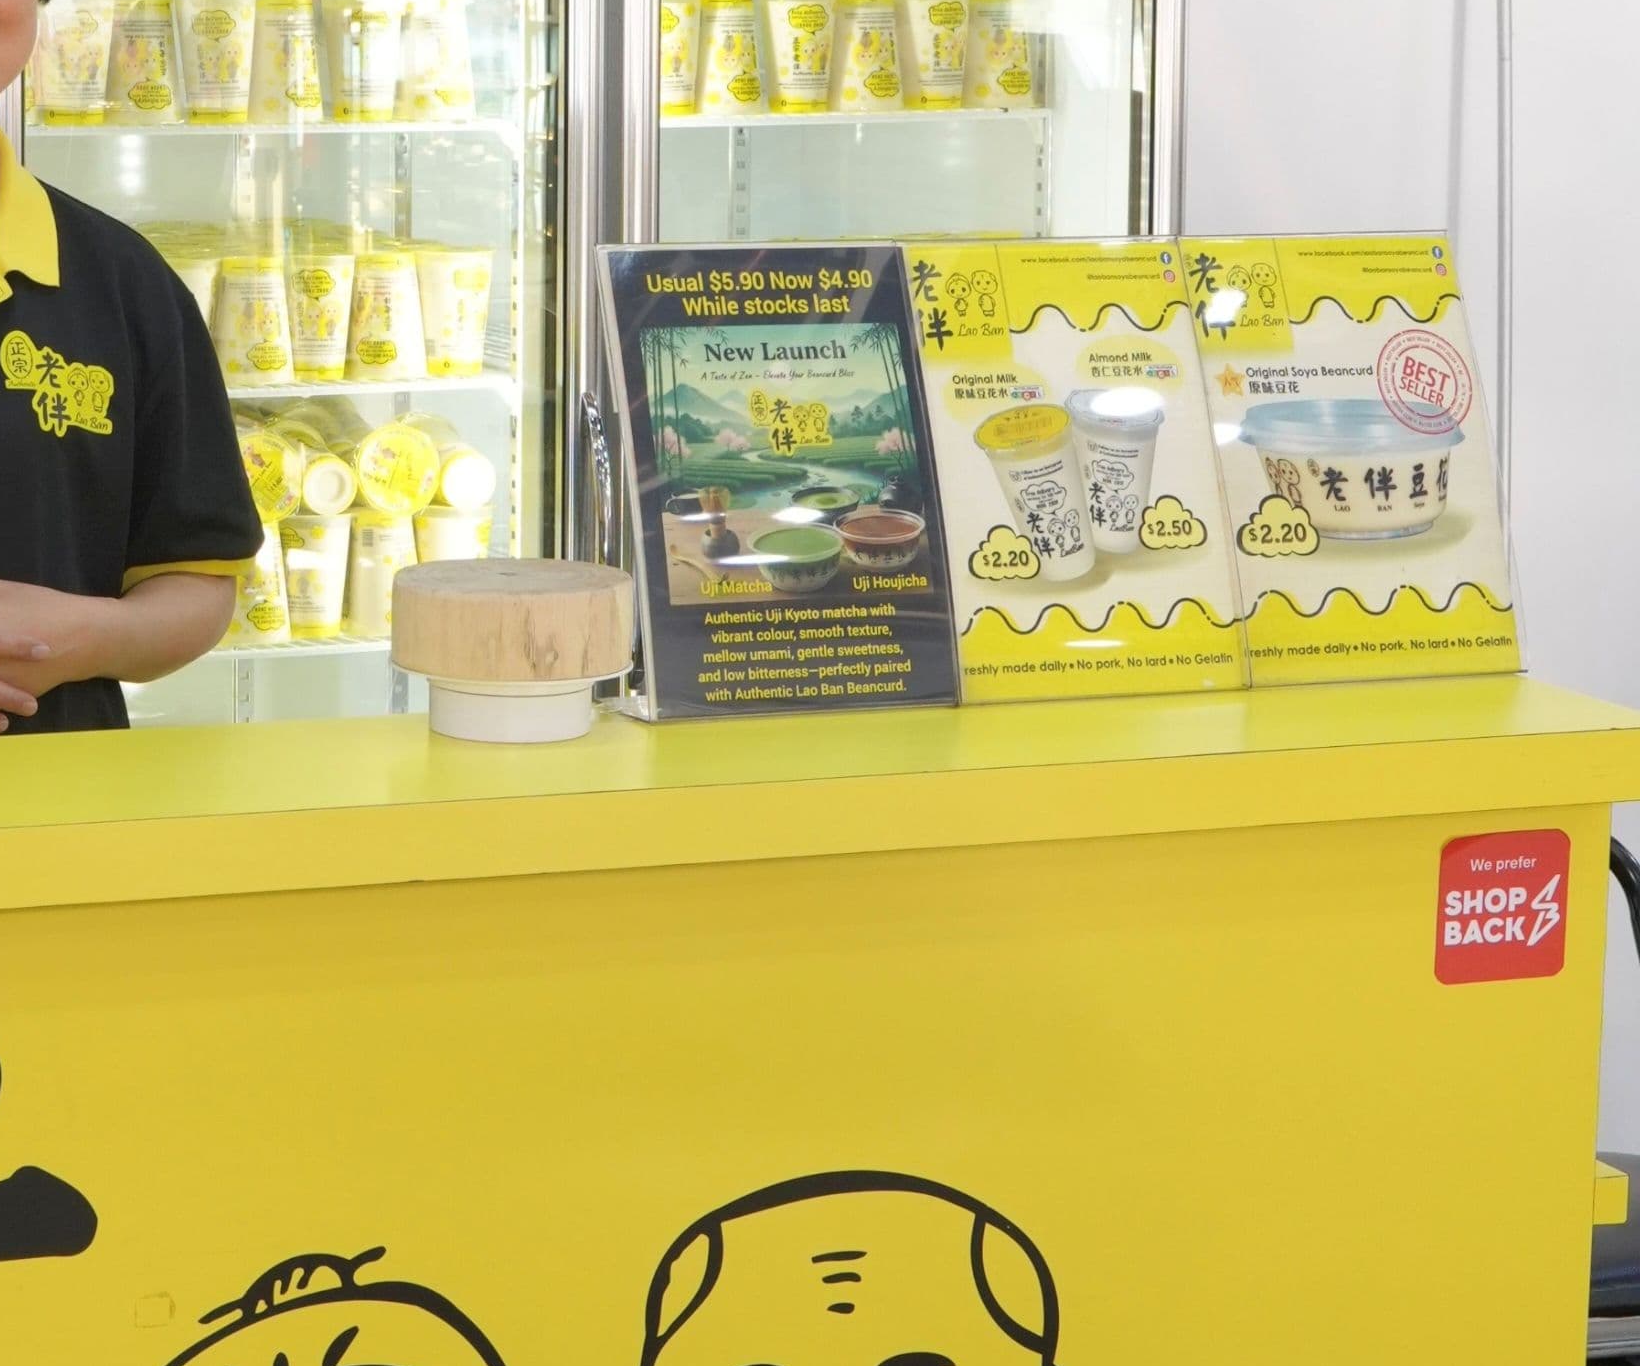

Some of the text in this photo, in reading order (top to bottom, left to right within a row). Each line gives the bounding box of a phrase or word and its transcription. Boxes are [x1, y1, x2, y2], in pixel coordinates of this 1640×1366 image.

[646, 269, 872, 293] Usual $5.90 Now $4.90
[682, 295, 850, 316] While stocks last
[11, 342, 28, 373] 正宗
[704, 339, 847, 362] New Launch
[1089, 352, 1152, 363] Almond Milk
[952, 373, 1018, 385] Original Milk
[1246, 365, 1373, 379] Original Soya Beancurd
[1402, 356, 1450, 385] BEST
[36, 352, 71, 431] 老伴
[1399, 377, 1445, 407] SELLER
[90, 417, 108, 431] Ban
[770, 398, 797, 451] 老伴
[1147, 520, 1192, 536] $2.50
[1249, 523, 1307, 544] $2.20
[983, 551, 1029, 567] $2.20
[701, 580, 773, 597] Uji Matcha
[853, 574, 927, 591] Uji Houjicha
[705, 603, 895, 625] Authentic Uji Kyoto matcha with
[712, 624, 892, 643] vibrant colour, smooth texture,
[703, 642, 904, 663] mellow umami, gentle sweetness,
[698, 659, 911, 683] and low paired
[706, 680, 907, 702] with Authentic Lao Ban Beancurd.
[1470, 855, 1537, 873] We prefer
[1444, 887, 1527, 916] SHOP
[1444, 916, 1526, 946] BACK
